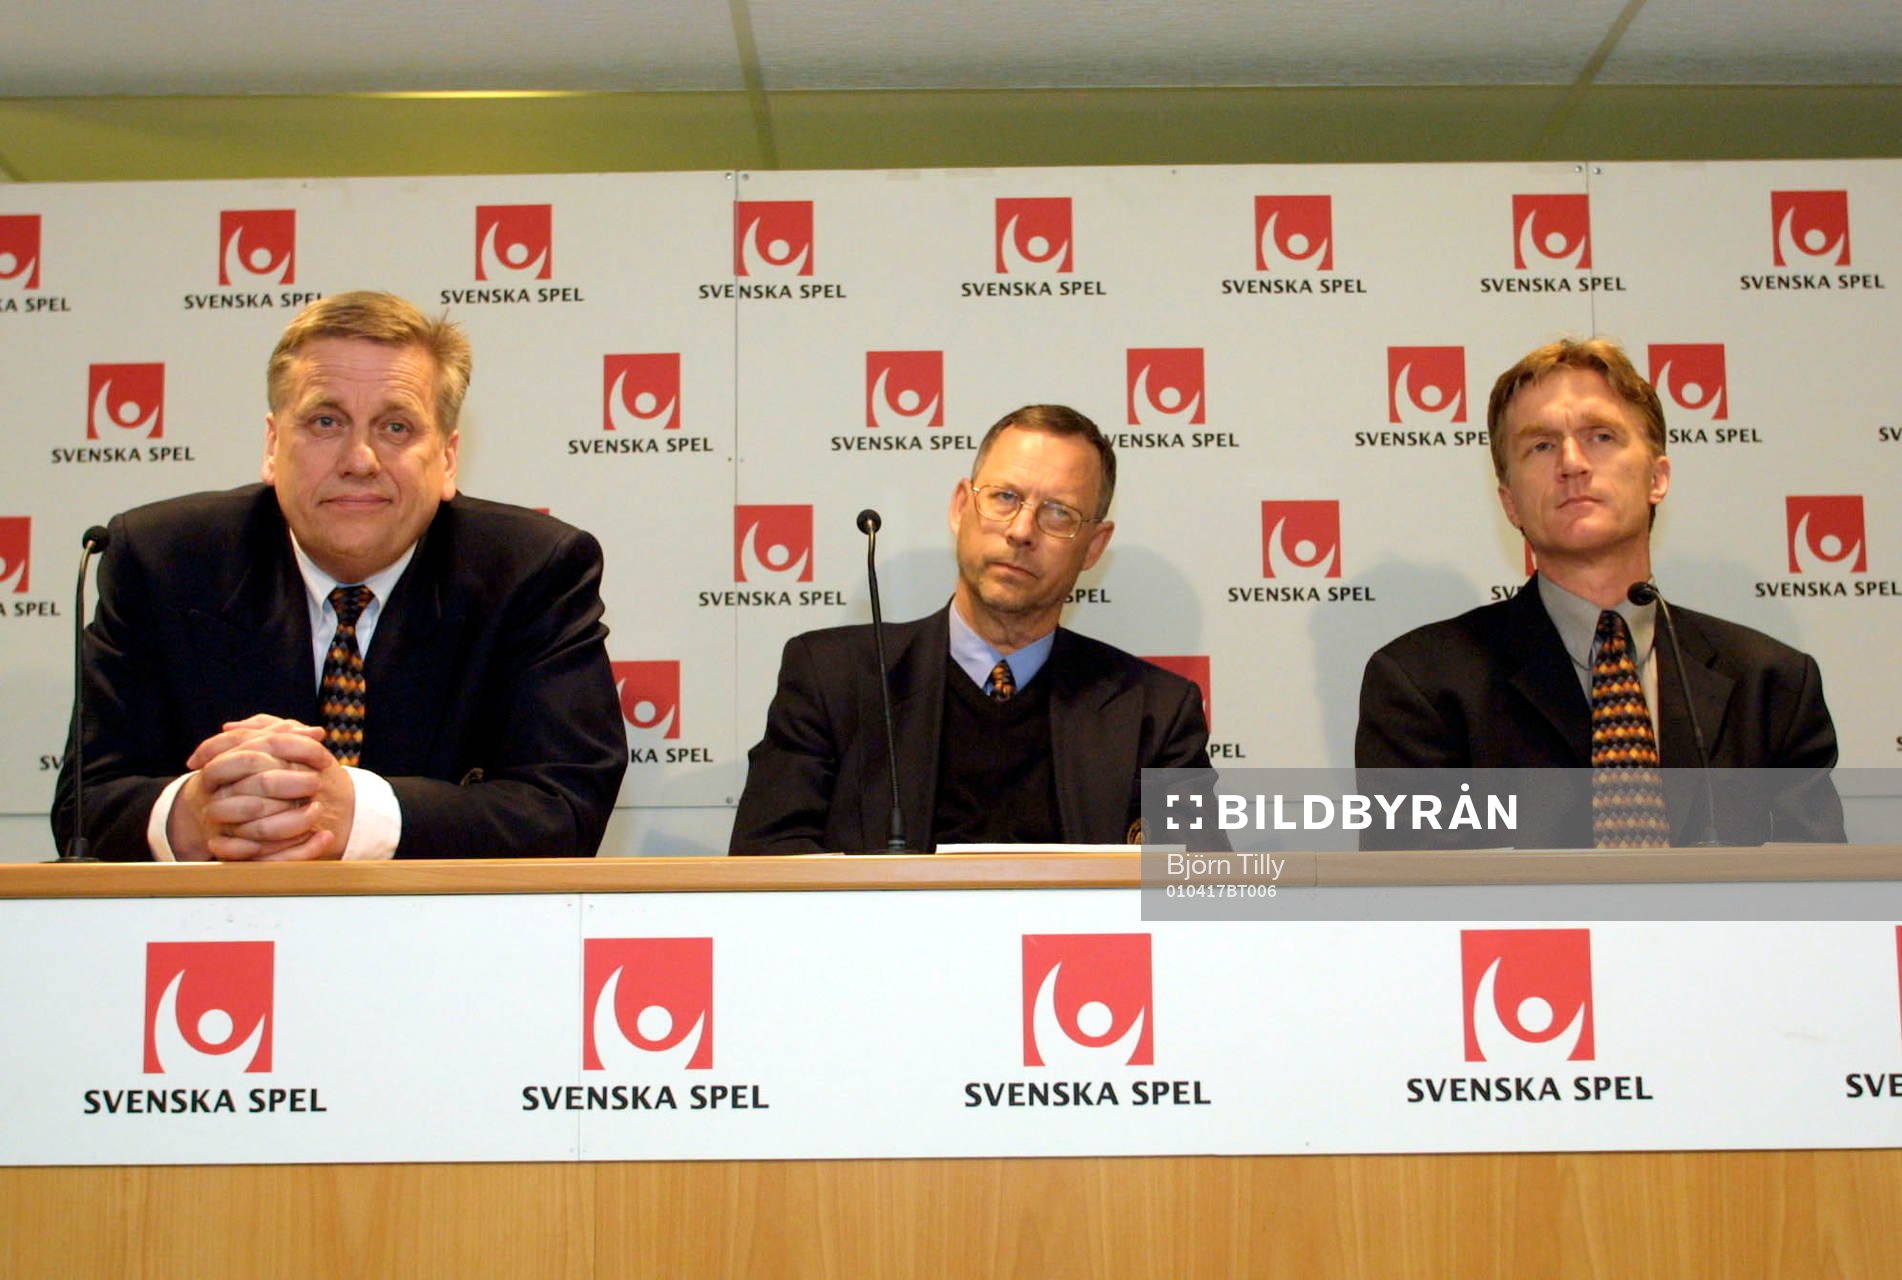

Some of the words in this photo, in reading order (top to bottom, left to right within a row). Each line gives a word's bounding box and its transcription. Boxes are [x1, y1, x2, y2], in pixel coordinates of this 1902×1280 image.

[961, 282, 1053, 298] SVENSKA
[1059, 281, 1107, 296] SPEL
[1221, 280, 1313, 295] SVENSKA
[1319, 279, 1367, 294] SPEL
[1480, 278, 1572, 293] SVENSKA
[1578, 277, 1626, 293] SPEL
[1740, 275, 1831, 290] SVENSKA
[1838, 275, 1885, 289] SPEL
[440, 289, 531, 305] SVENSKA
[537, 288, 584, 303] SPEL
[698, 284, 793, 300] SVENSKA
[799, 285, 847, 299] SPEL
[25, 298, 69, 313] SPEL
[184, 294, 273, 310] SVENSKA
[831, 436, 923, 452] SVENSKA
[929, 436, 977, 451] SPEL
[1104, 433, 1185, 449] VENSKA
[1191, 433, 1240, 448] SPEL
[1354, 432, 1447, 447] SVENSKA
[1453, 431, 1489, 447] SPE
[1715, 429, 1762, 444] SPEL
[568, 439, 659, 455] SVENSKA
[666, 438, 713, 453] SPEL
[51, 448, 141, 464] SVENSKA
[148, 447, 194, 462] SPEL
[1227, 587, 1321, 603] SVENSKA
[1327, 587, 1377, 603] SPEL
[1754, 582, 1847, 598] SVENSKA
[1854, 582, 1902, 597] SPEL
[698, 592, 792, 607] SVENSKA
[799, 591, 847, 606] SPEL
[14, 602, 60, 617] SPEL
[665, 748, 714, 764] SPEL
[1210, 744, 1246, 759] PEL
[964, 1082, 1120, 1108] SVENSKA
[1131, 1081, 1212, 1107] SPEL
[1406, 1077, 1562, 1104] SVENSKA
[1573, 1076, 1654, 1102] SPEL
[83, 1089, 237, 1115] SVENSKA
[248, 1088, 328, 1114] SPEL
[521, 1086, 678, 1112] SVENSKA
[689, 1085, 770, 1111] SPEL
